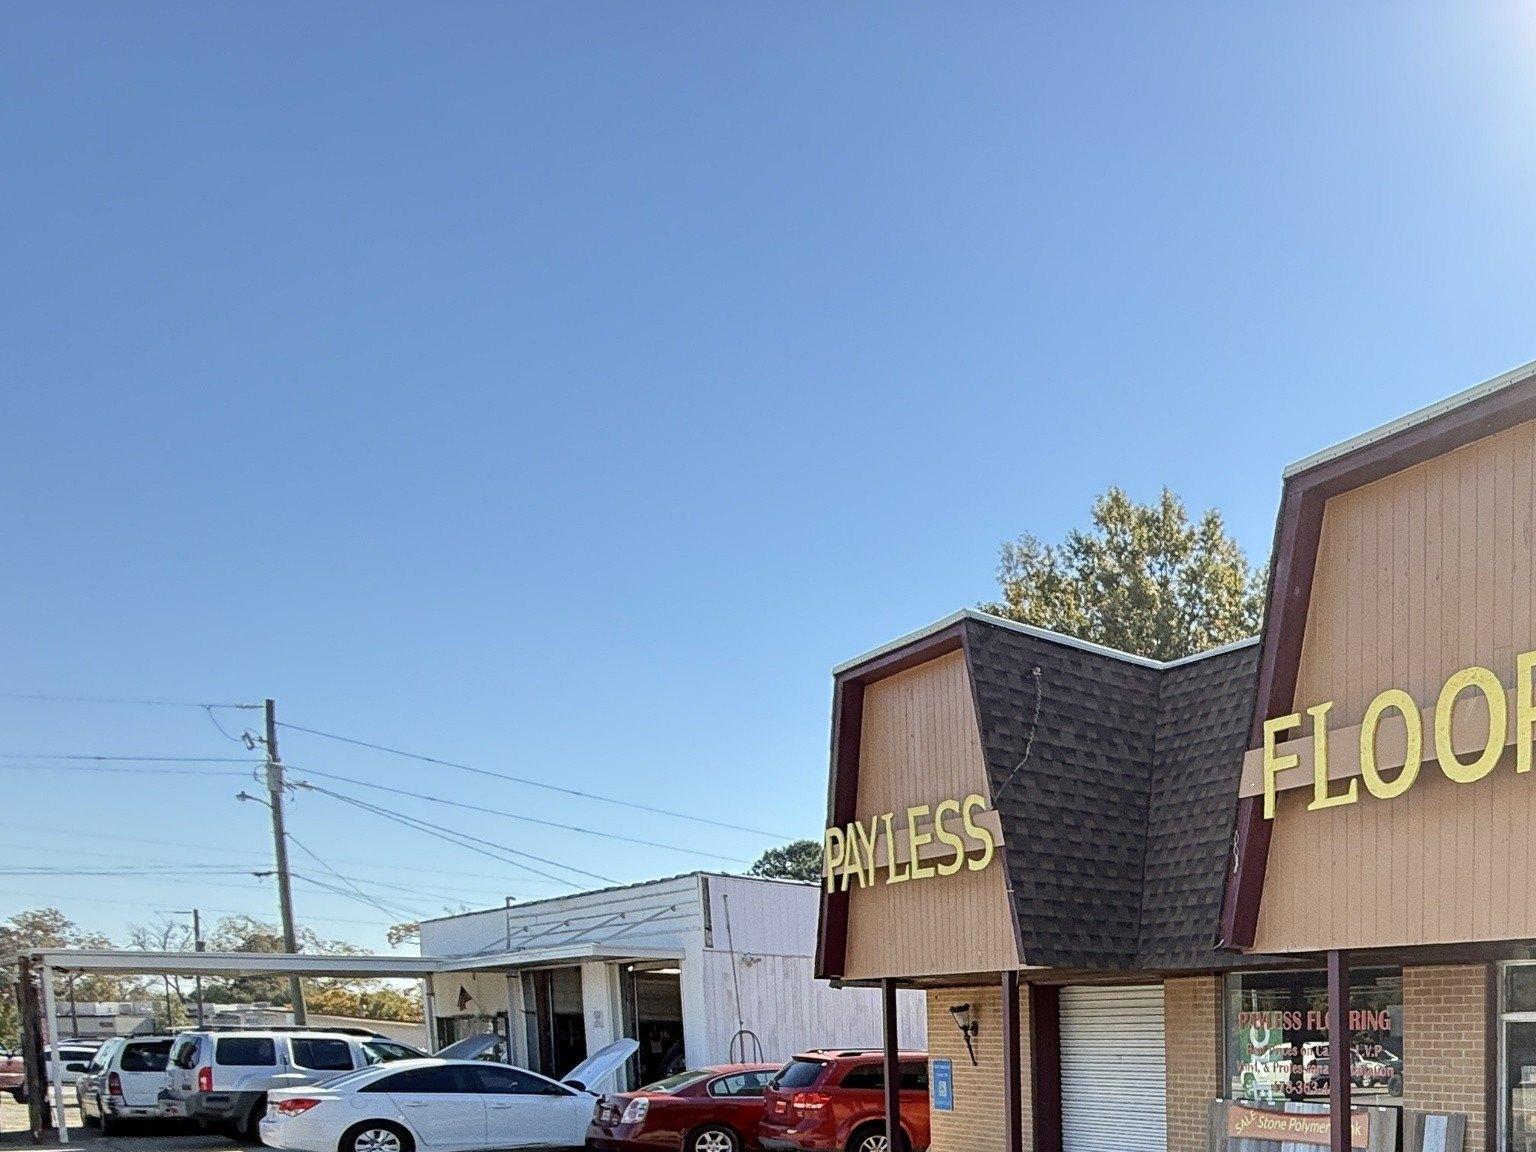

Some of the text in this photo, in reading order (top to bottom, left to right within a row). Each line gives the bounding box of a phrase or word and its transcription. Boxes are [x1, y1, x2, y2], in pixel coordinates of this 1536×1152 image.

[825, 793, 995, 893] PAYLESS
[1307, 1011, 1391, 1032] FLRING
[1273, 1061, 1330, 1075] Professiona
[1271, 1080, 1330, 1095] 478-363-4
[1235, 1109, 1258, 1134] SALE
[1257, 1115, 1286, 1131] Stone
